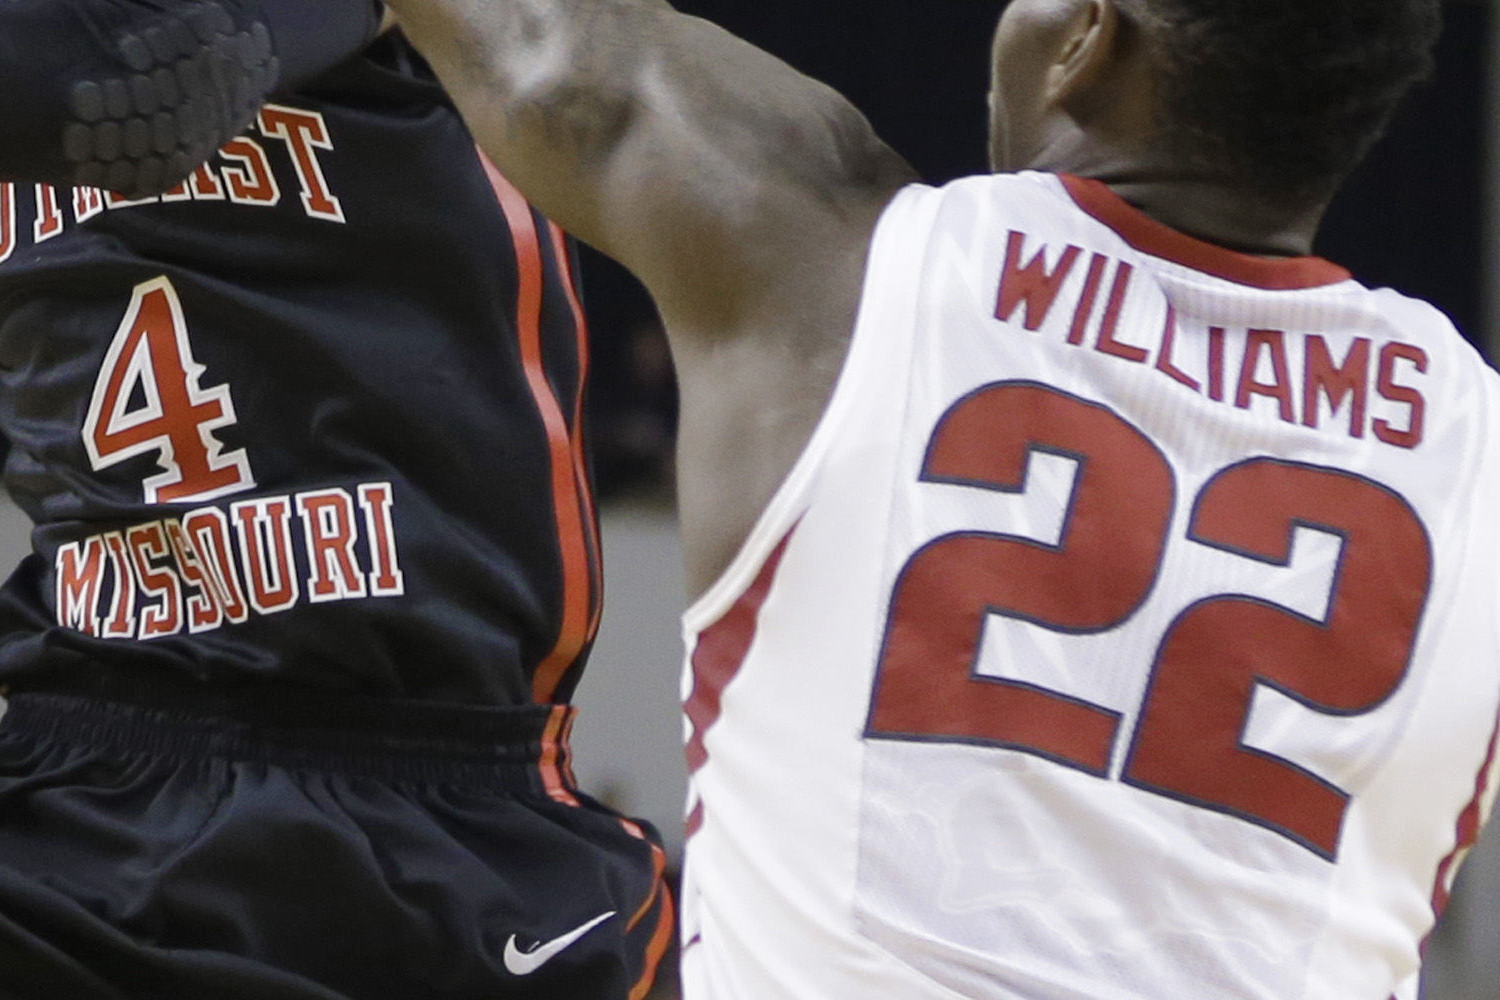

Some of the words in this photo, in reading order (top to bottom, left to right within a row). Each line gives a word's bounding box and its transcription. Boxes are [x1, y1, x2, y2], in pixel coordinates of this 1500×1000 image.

[81, 274, 257, 504] 4
[993, 229, 1428, 450] WILLIAMS
[55, 481, 404, 640] MISSOURI
[863, 378, 1435, 864] 22
